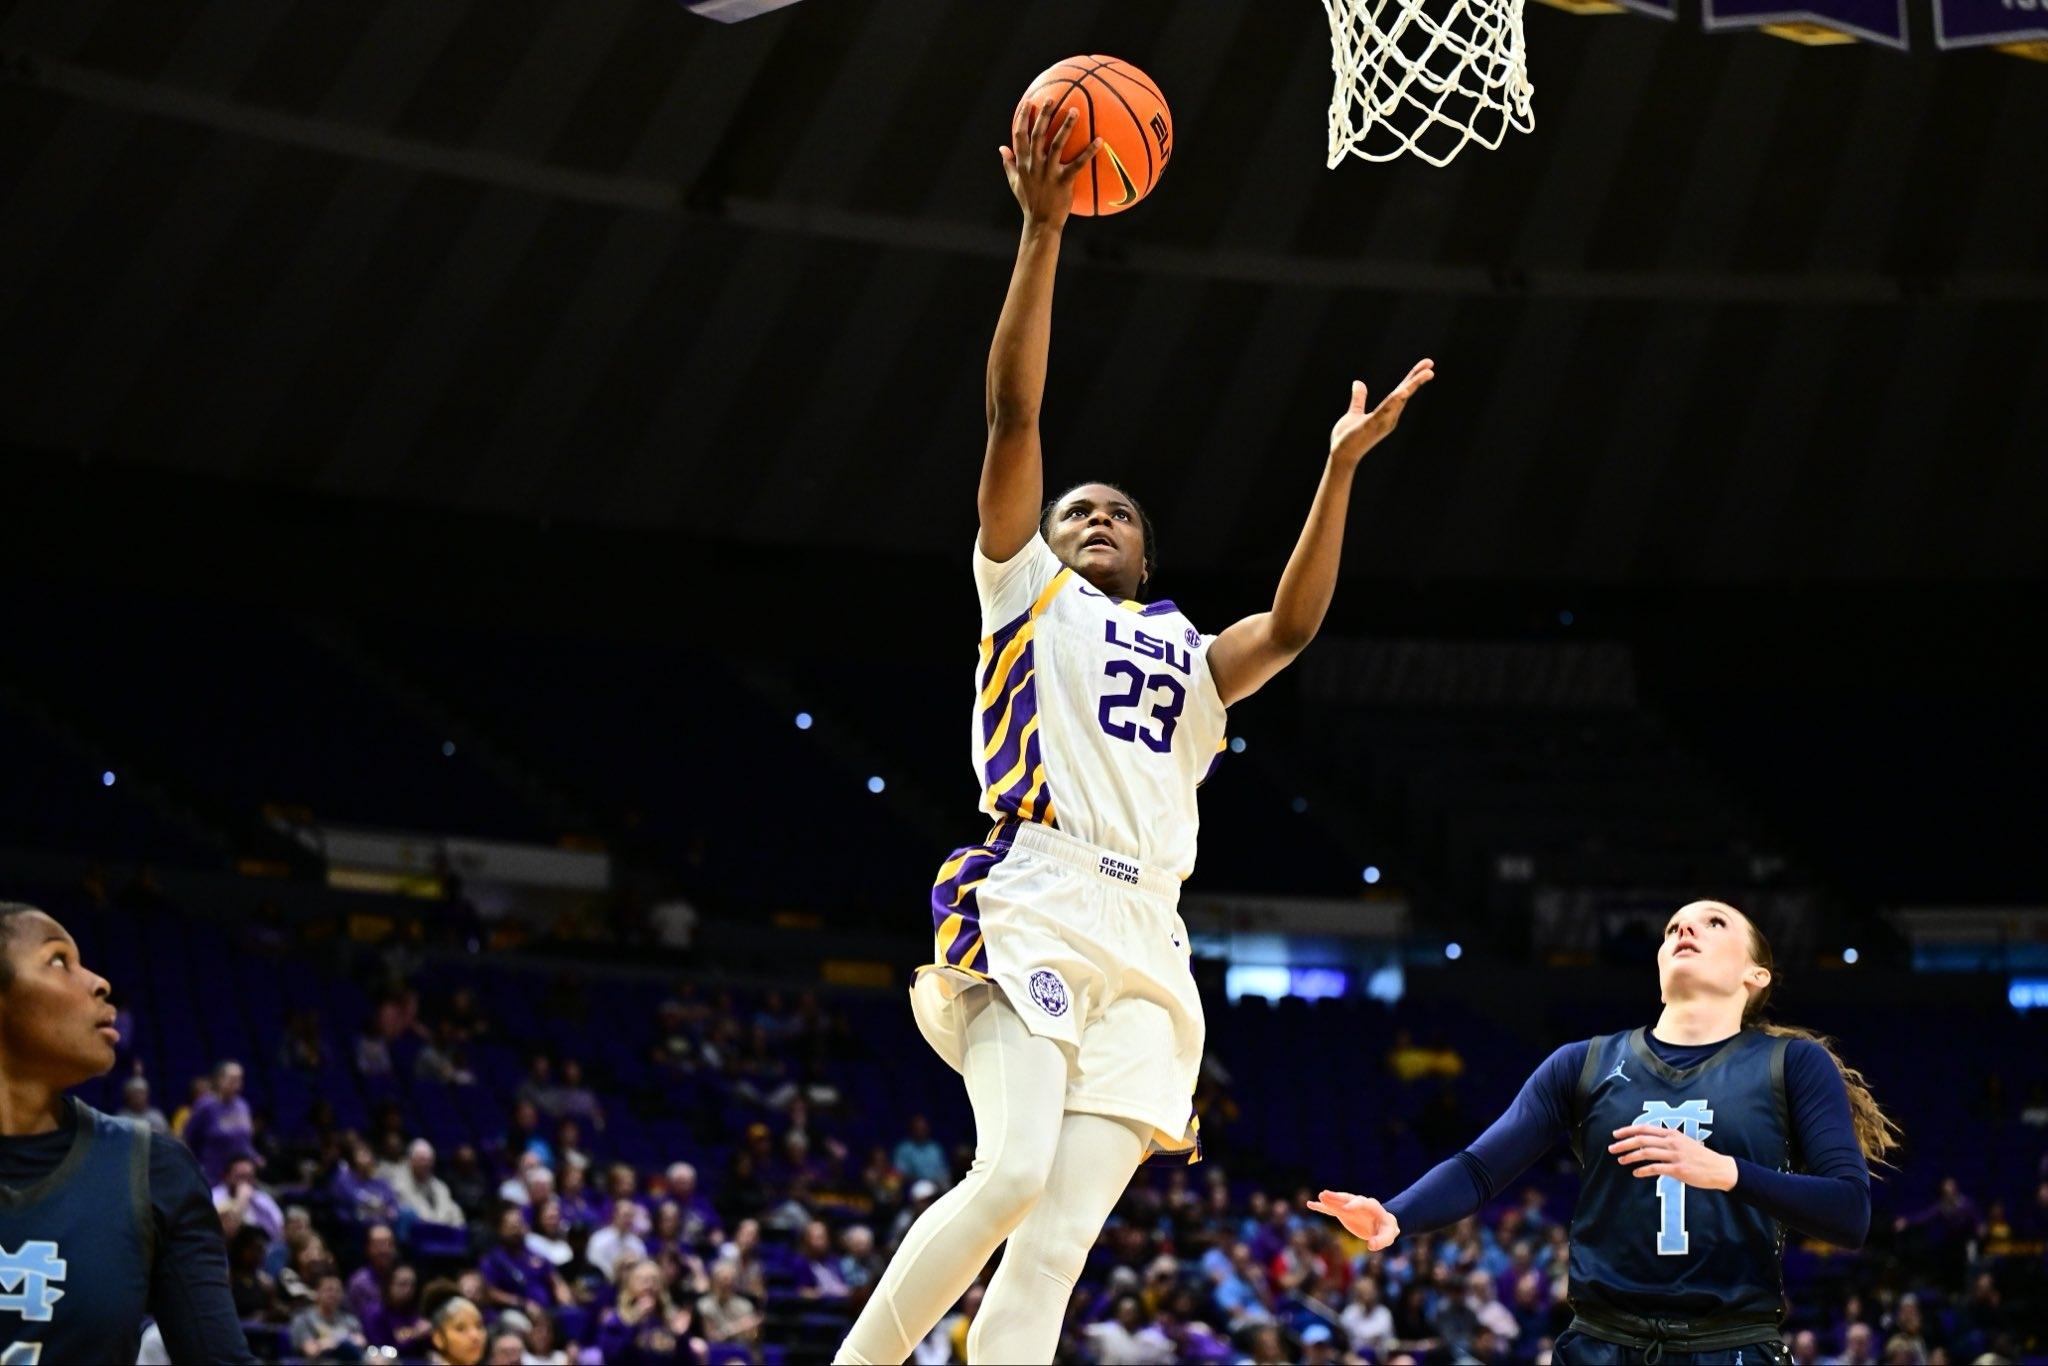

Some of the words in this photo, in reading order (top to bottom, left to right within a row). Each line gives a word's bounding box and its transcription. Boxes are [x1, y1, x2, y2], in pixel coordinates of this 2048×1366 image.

[1105, 619, 1191, 675] LSU
[1185, 629, 1201, 648] SEC
[1098, 660, 1186, 753] 23
[1099, 864, 1139, 885] TIGERS
[1101, 856, 1139, 876] GEAUX
[1656, 1174, 1689, 1256] 1
